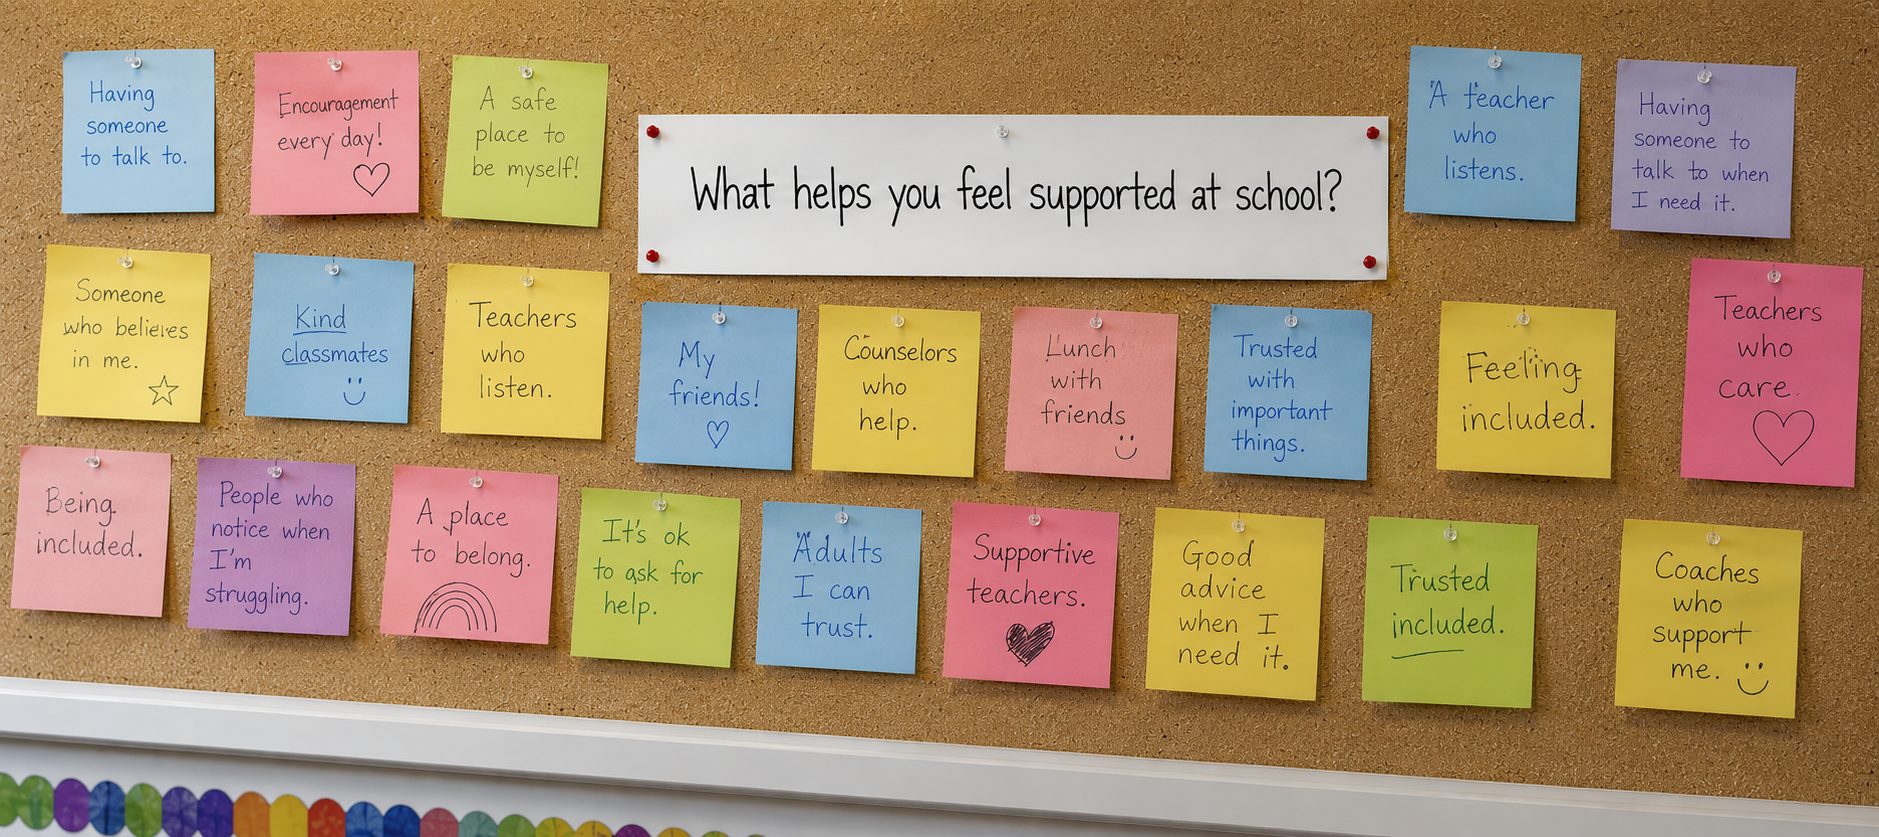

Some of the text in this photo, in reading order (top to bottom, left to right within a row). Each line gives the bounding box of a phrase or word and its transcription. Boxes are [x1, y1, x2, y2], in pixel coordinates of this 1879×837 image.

[90, 79, 155, 113] Having
[278, 87, 400, 122] Encouragement
[479, 84, 558, 111] A safe
[1428, 79, 1555, 110] A teacher
[1639, 91, 1711, 128] Having
[86, 120, 169, 135] someone
[277, 121, 383, 161] every day!
[475, 120, 566, 150] place to
[1453, 120, 1497, 145] who
[1634, 129, 1751, 150] someone to
[80, 144, 188, 167] to talk to.
[1445, 155, 1524, 182] listens.
[472, 154, 580, 189] be myself!
[1631, 158, 1769, 183] talk to when
[689, 164, 1343, 229] What helps you feel supported at school?
[1631, 190, 1736, 213] I need it.
[75, 277, 166, 304] Someone
[296, 303, 346, 330] Kind
[468, 300, 577, 329] Teachers
[1713, 294, 1825, 322] Teachers
[62, 314, 103, 336] who
[72, 349, 138, 370] in me.
[281, 340, 389, 366] classmates
[480, 340, 526, 364] who
[843, 334, 958, 363] Counselors
[1045, 333, 1116, 363] Lunch
[1232, 333, 1318, 359] Trusted
[1737, 332, 1793, 358] who
[678, 340, 716, 380] My
[1466, 346, 1583, 395] Feeling
[480, 373, 552, 399] listen.
[668, 378, 760, 408] friends!
[862, 372, 907, 396] who
[1050, 367, 1102, 390] with
[1247, 367, 1295, 390] with
[859, 407, 917, 441] help.
[1040, 398, 1126, 426] friends
[1231, 398, 1334, 429] important
[1462, 398, 1595, 433] included.
[1231, 428, 1305, 463] things.
[45, 486, 117, 528] Being
[219, 480, 334, 515] People who
[211, 516, 330, 541] notice when
[415, 496, 509, 537] A place
[36, 528, 143, 558] included.
[601, 518, 691, 547] It's ok
[792, 530, 883, 564] Adults
[208, 547, 252, 571] I'm
[410, 538, 531, 579] to belong.
[972, 532, 1096, 574] Supportive
[1182, 539, 1255, 572] Good
[1655, 550, 1760, 585] Coaches
[592, 556, 704, 585] to ask for
[1390, 561, 1490, 593] Trusted
[204, 580, 308, 616] struggling.
[792, 574, 870, 601] I can
[966, 577, 1086, 608] teachers.
[1180, 573, 1266, 600] advice
[1672, 588, 1723, 614] who
[604, 589, 657, 626] help.
[1178, 608, 1280, 635] when I
[1392, 604, 1505, 639] included.
[800, 611, 873, 639] trust.
[1652, 620, 1753, 654] support
[1178, 640, 1289, 671] need it.
[1671, 663, 1720, 680] me.
